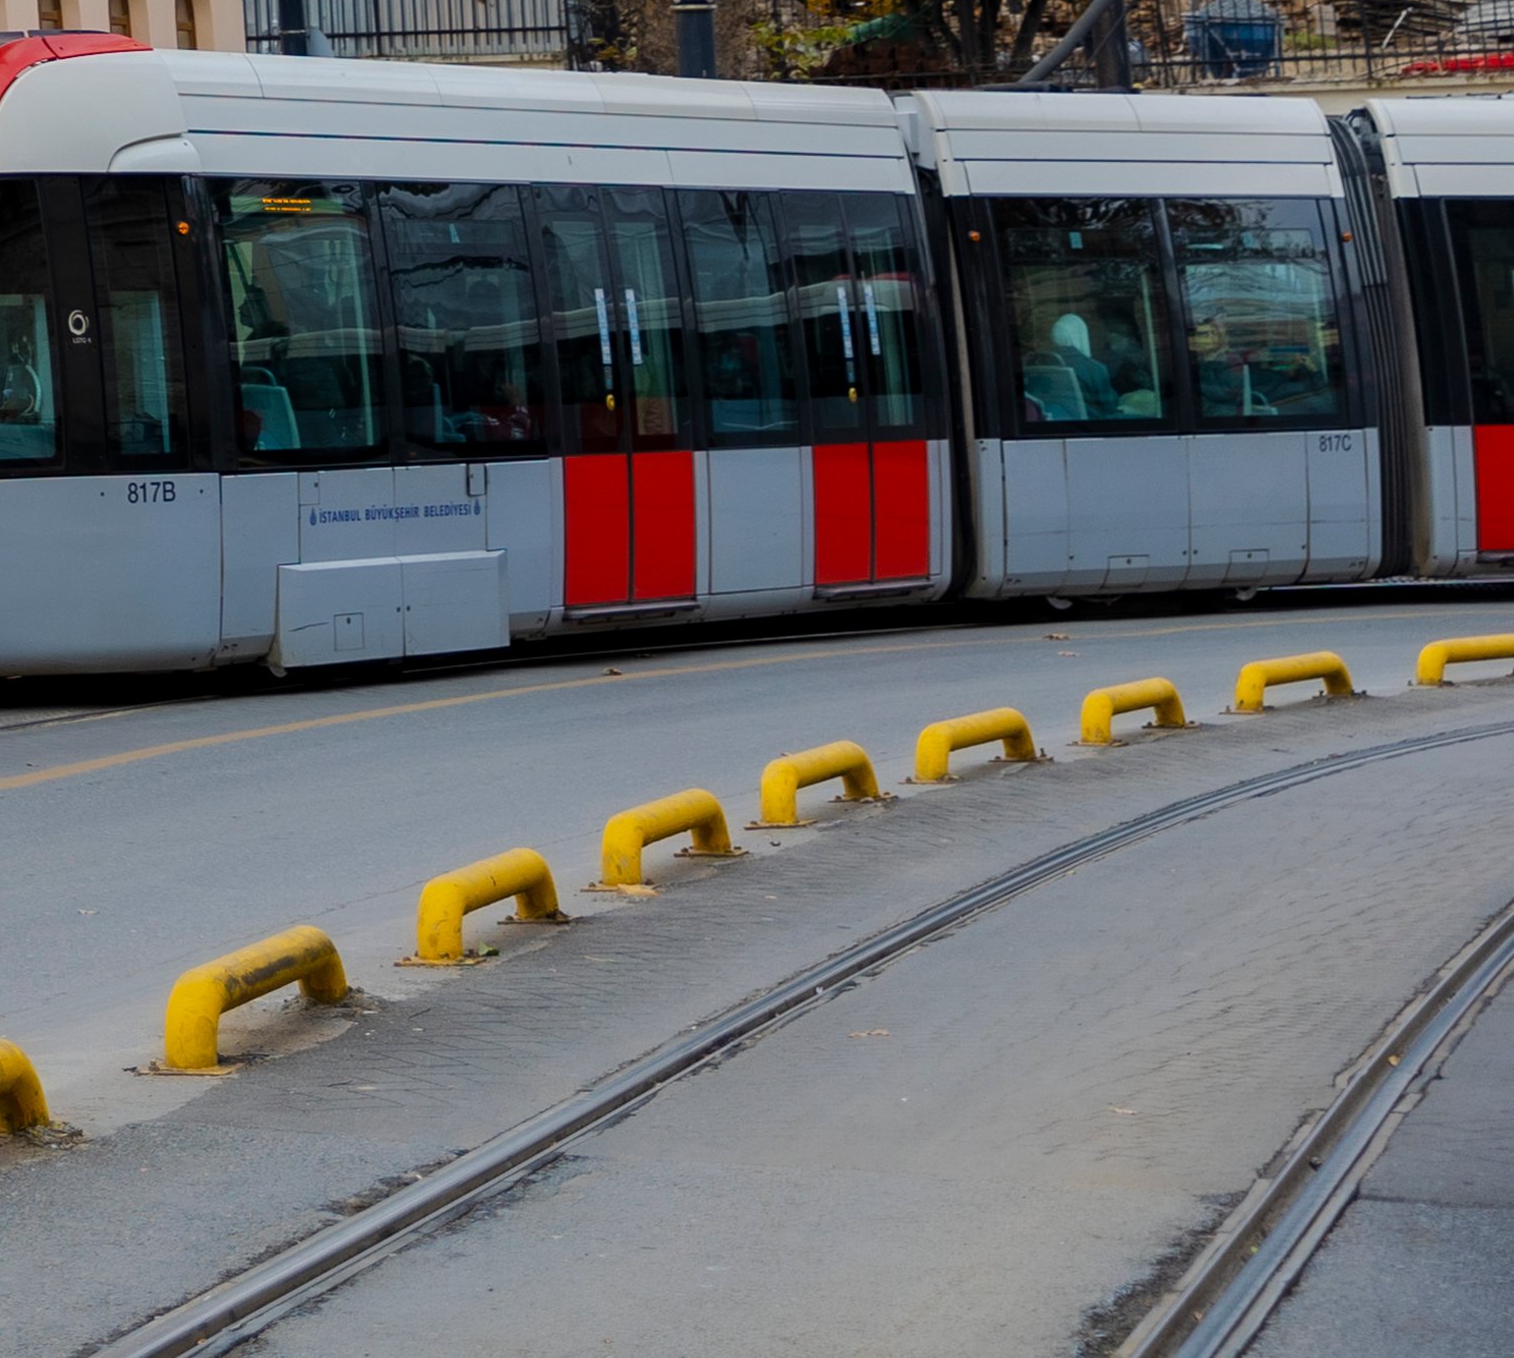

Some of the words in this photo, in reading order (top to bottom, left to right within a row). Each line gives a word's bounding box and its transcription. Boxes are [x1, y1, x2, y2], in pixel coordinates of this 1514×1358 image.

[1319, 434, 1353, 452] 817C
[127, 481, 176, 504] 817B
[319, 508, 362, 524] İSTANBUL
[365, 503, 420, 523] BÜYÜKŞEHİR
[424, 501, 472, 518] BELEDİYESİ
